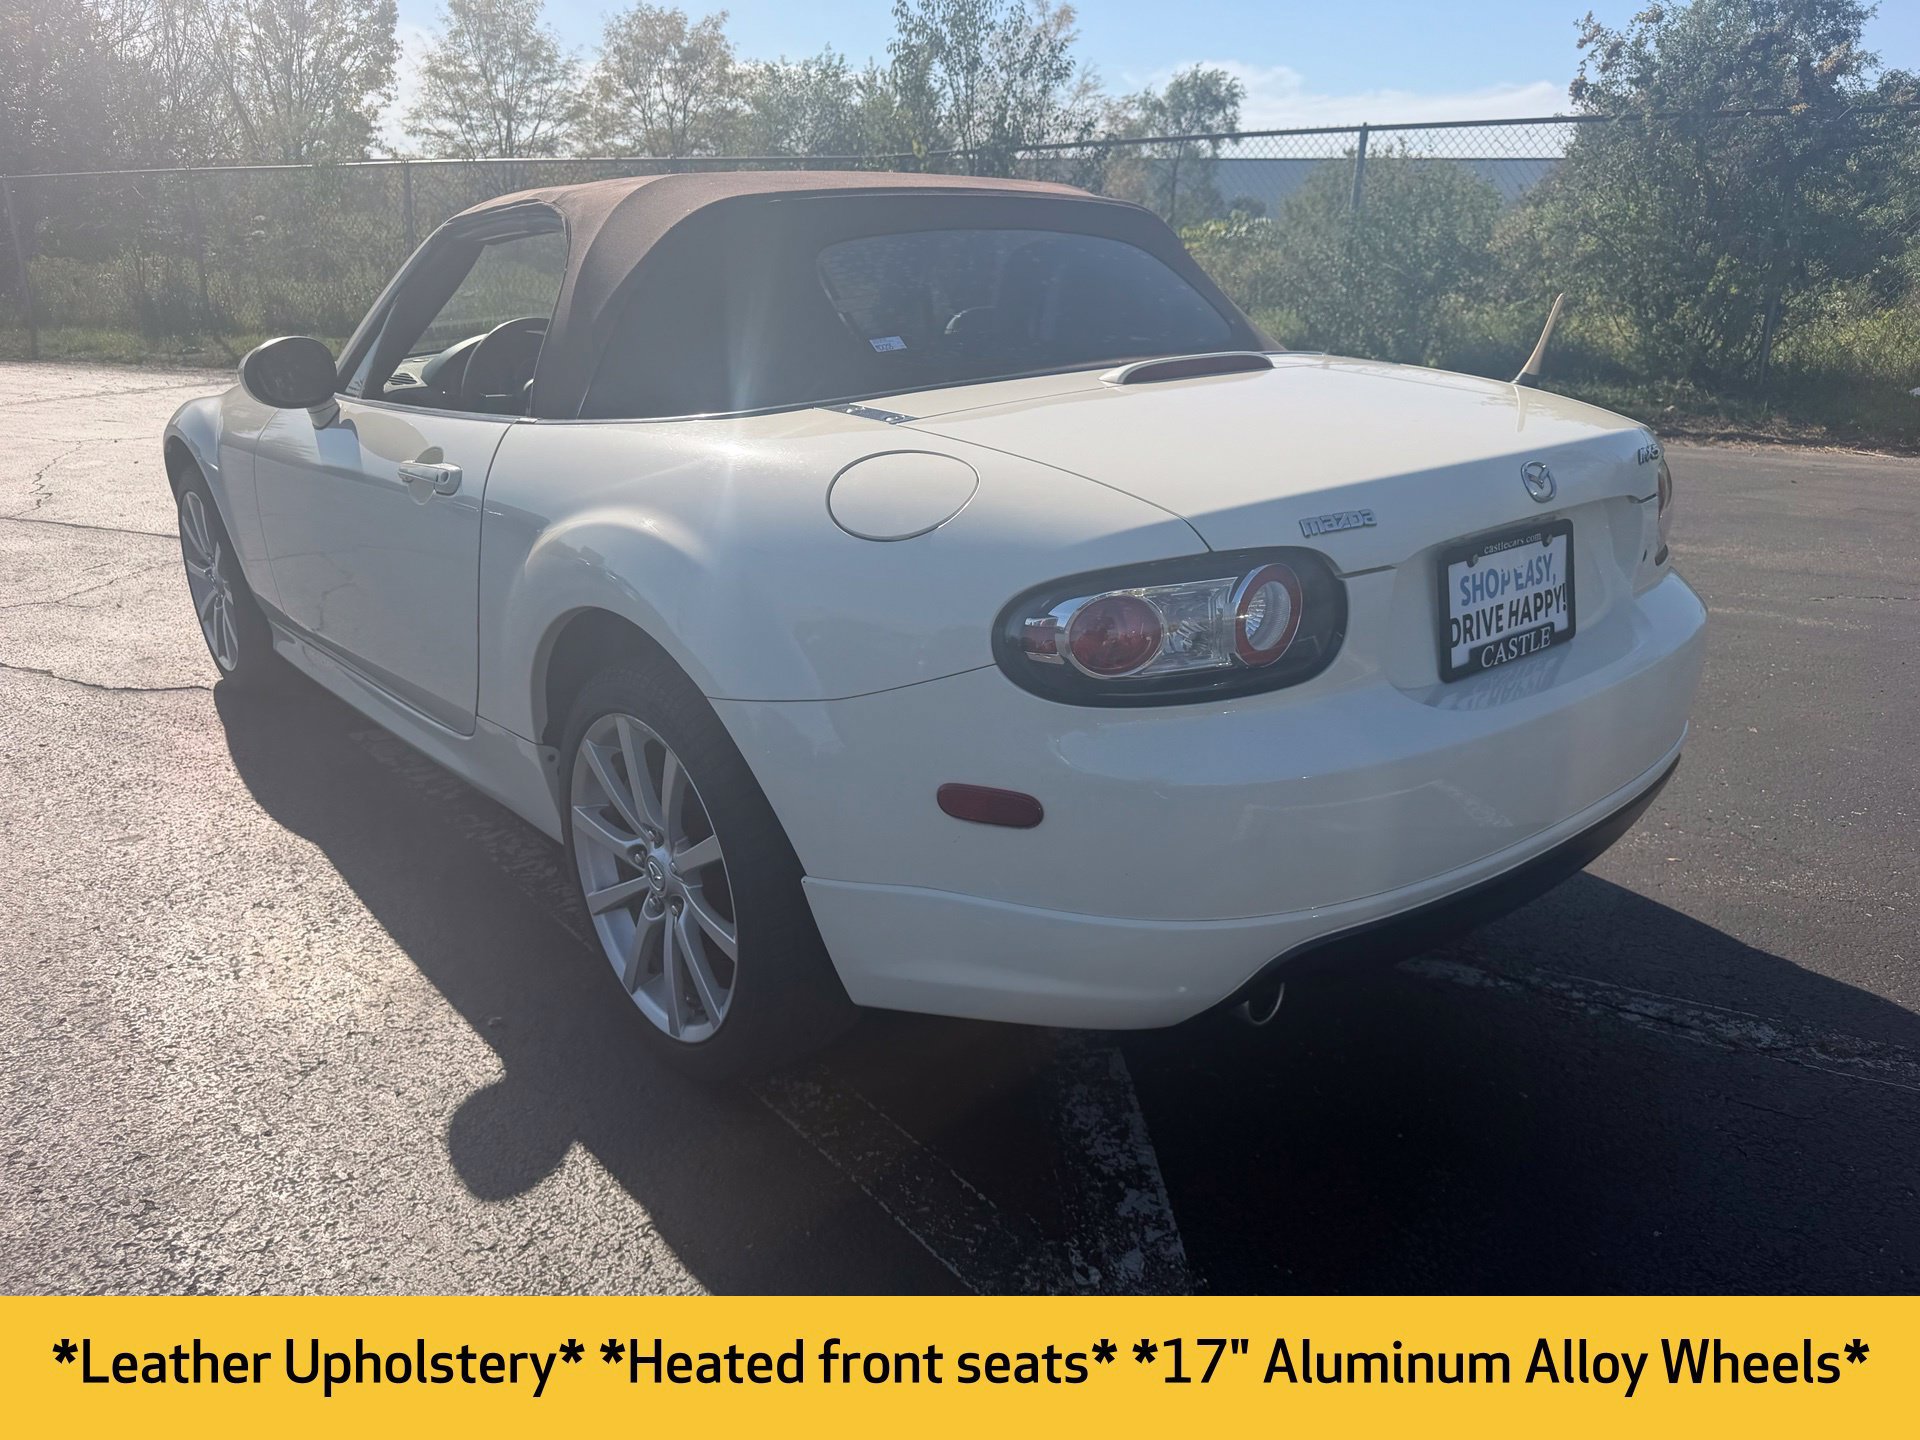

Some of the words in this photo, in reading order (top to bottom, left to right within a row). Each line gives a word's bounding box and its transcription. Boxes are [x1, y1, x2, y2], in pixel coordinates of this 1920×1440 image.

[1484, 533, 1542, 555] castlecars.com
[1460, 567, 1511, 607] SHOP
[1514, 553, 1557, 591] EASY,
[1450, 603, 1504, 649] DRIVE
[1508, 583, 1567, 629] HAPPY!
[1481, 626, 1552, 668] CASTLE
